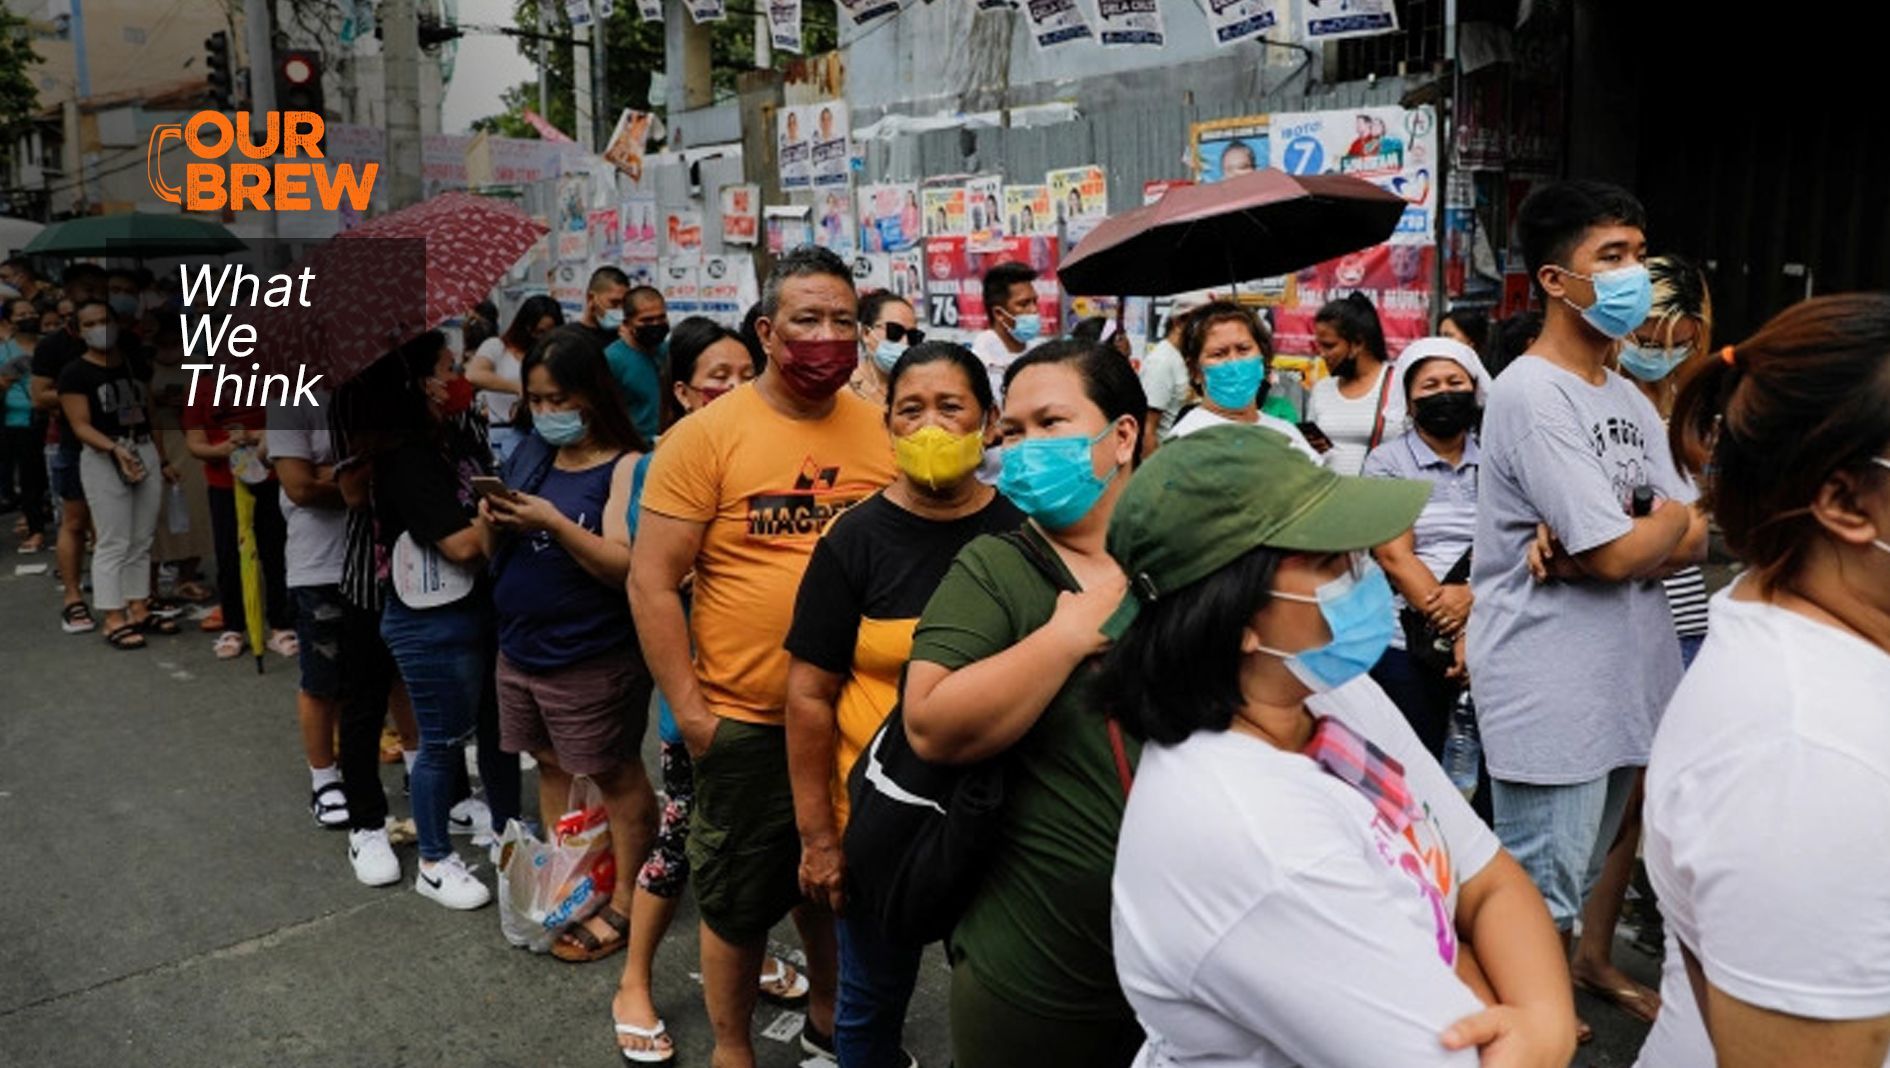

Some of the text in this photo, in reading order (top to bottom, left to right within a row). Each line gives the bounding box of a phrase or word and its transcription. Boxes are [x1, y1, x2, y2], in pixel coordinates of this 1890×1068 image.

[1293, 141, 1316, 175] 7
[931, 295, 958, 326] 76
[542, 877, 593, 930] SUPER
